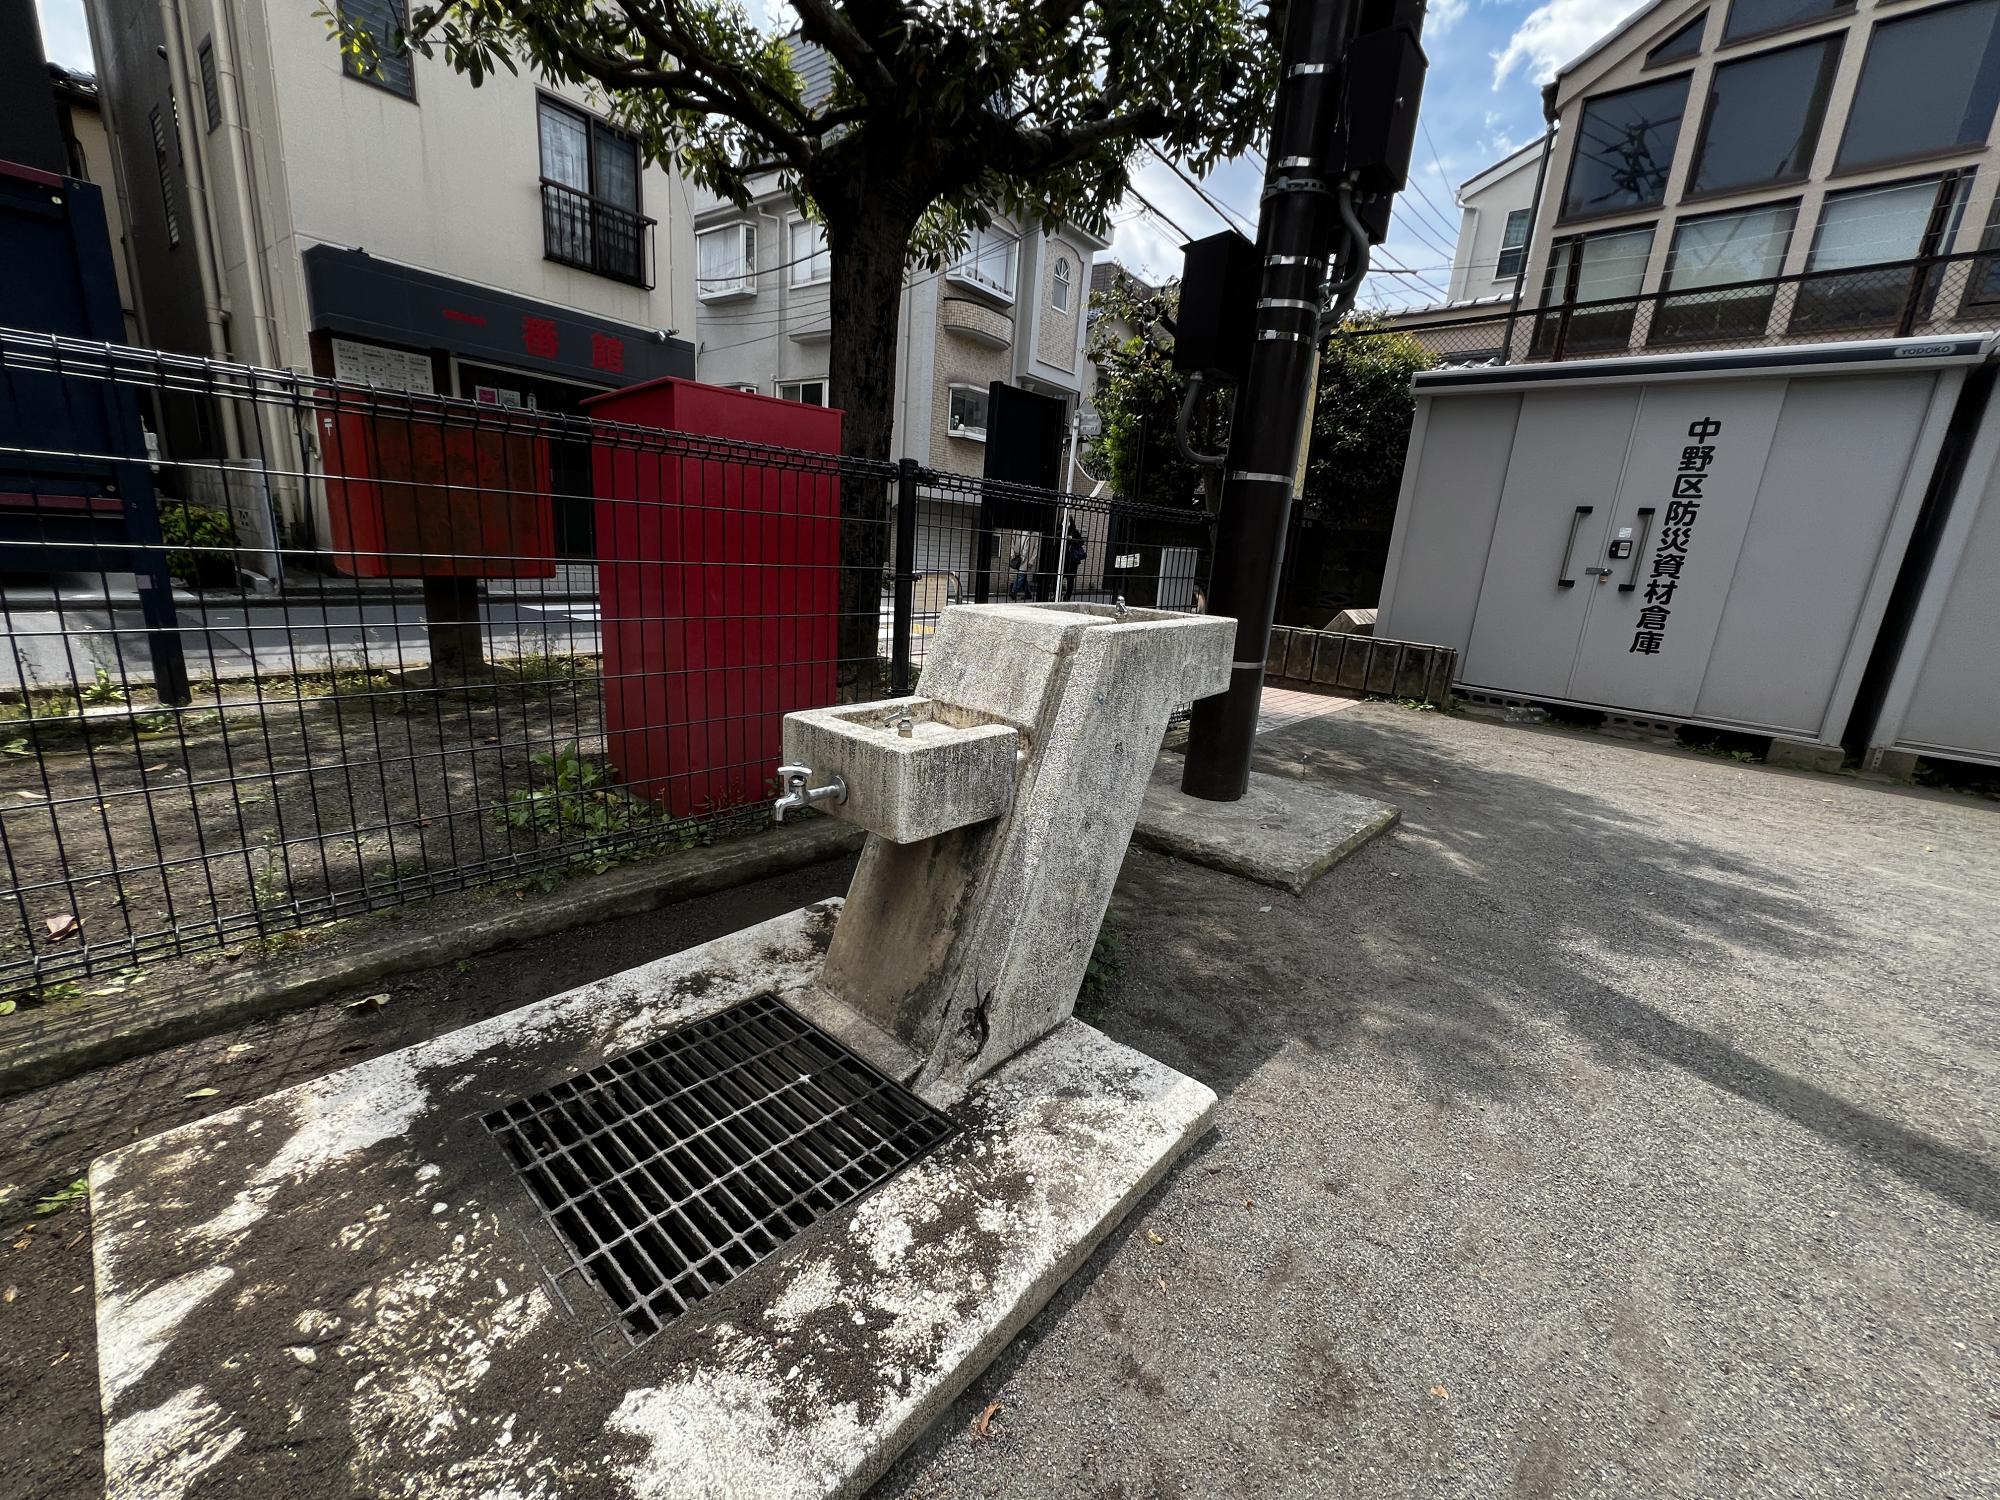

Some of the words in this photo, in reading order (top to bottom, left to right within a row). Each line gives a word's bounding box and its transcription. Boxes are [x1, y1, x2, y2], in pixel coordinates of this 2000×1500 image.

[1901, 345, 1951, 355] YODOKO
[1630, 417, 1721, 655] 中野区防災資材倉庫
